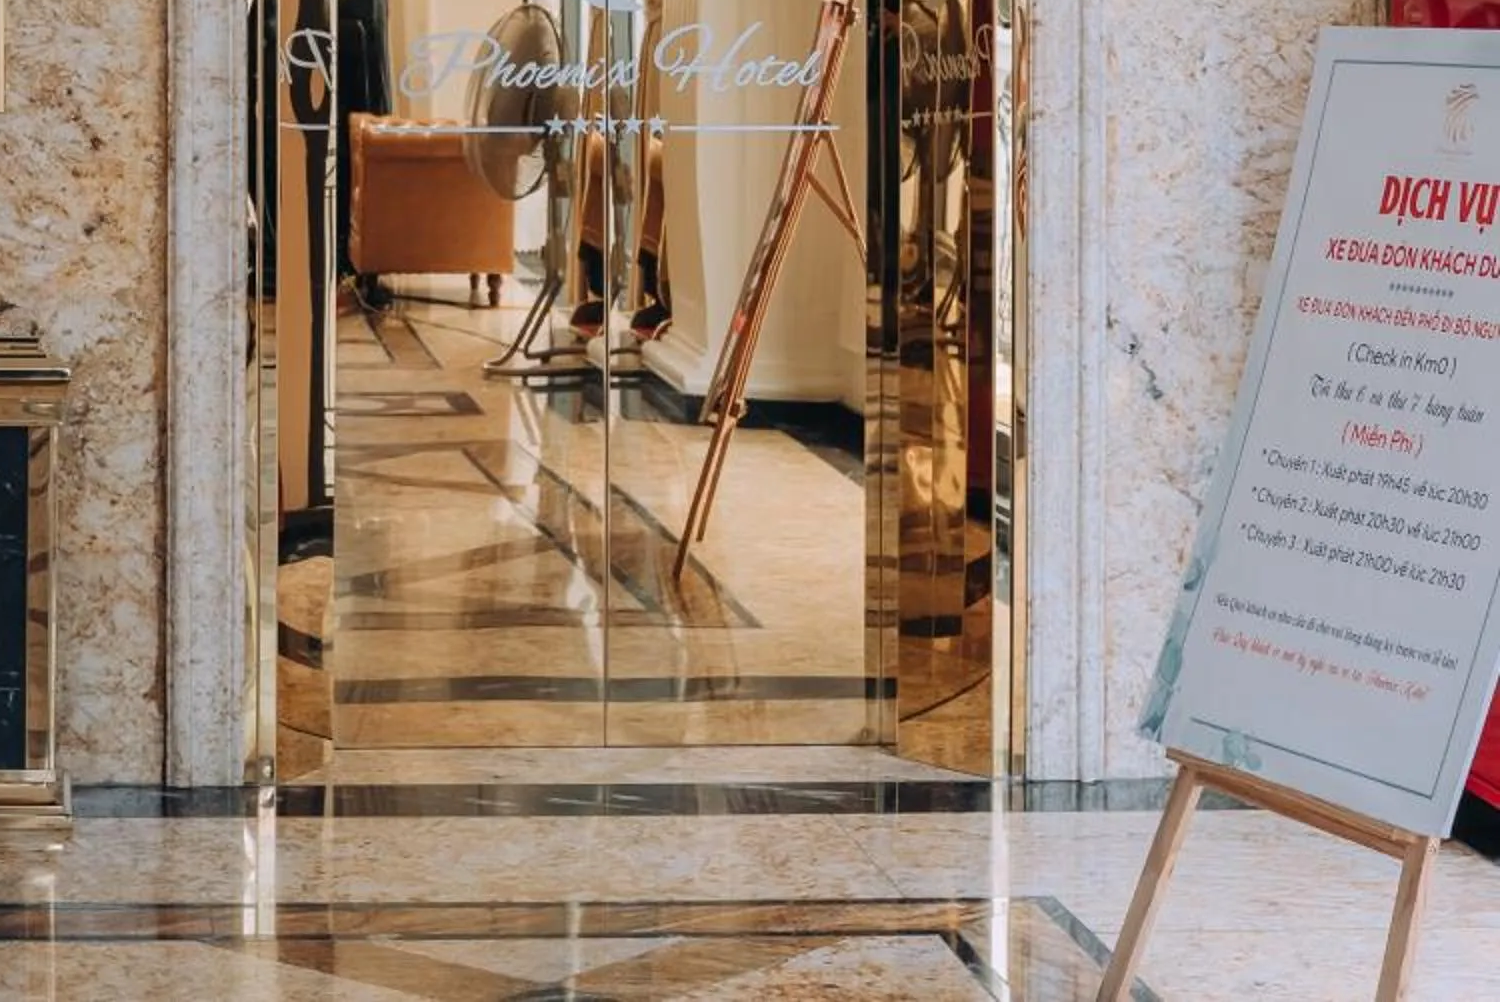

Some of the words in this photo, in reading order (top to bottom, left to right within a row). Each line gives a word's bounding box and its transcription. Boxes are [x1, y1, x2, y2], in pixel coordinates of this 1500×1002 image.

[400, 29, 642, 98] Phoenix
[654, 23, 822, 93] Hotel
[1379, 175, 1452, 226] DỊCH
[1325, 238, 1347, 260] XE
[1419, 246, 1477, 275] KHÁCH
[1447, 487, 1489, 511] 20h30
